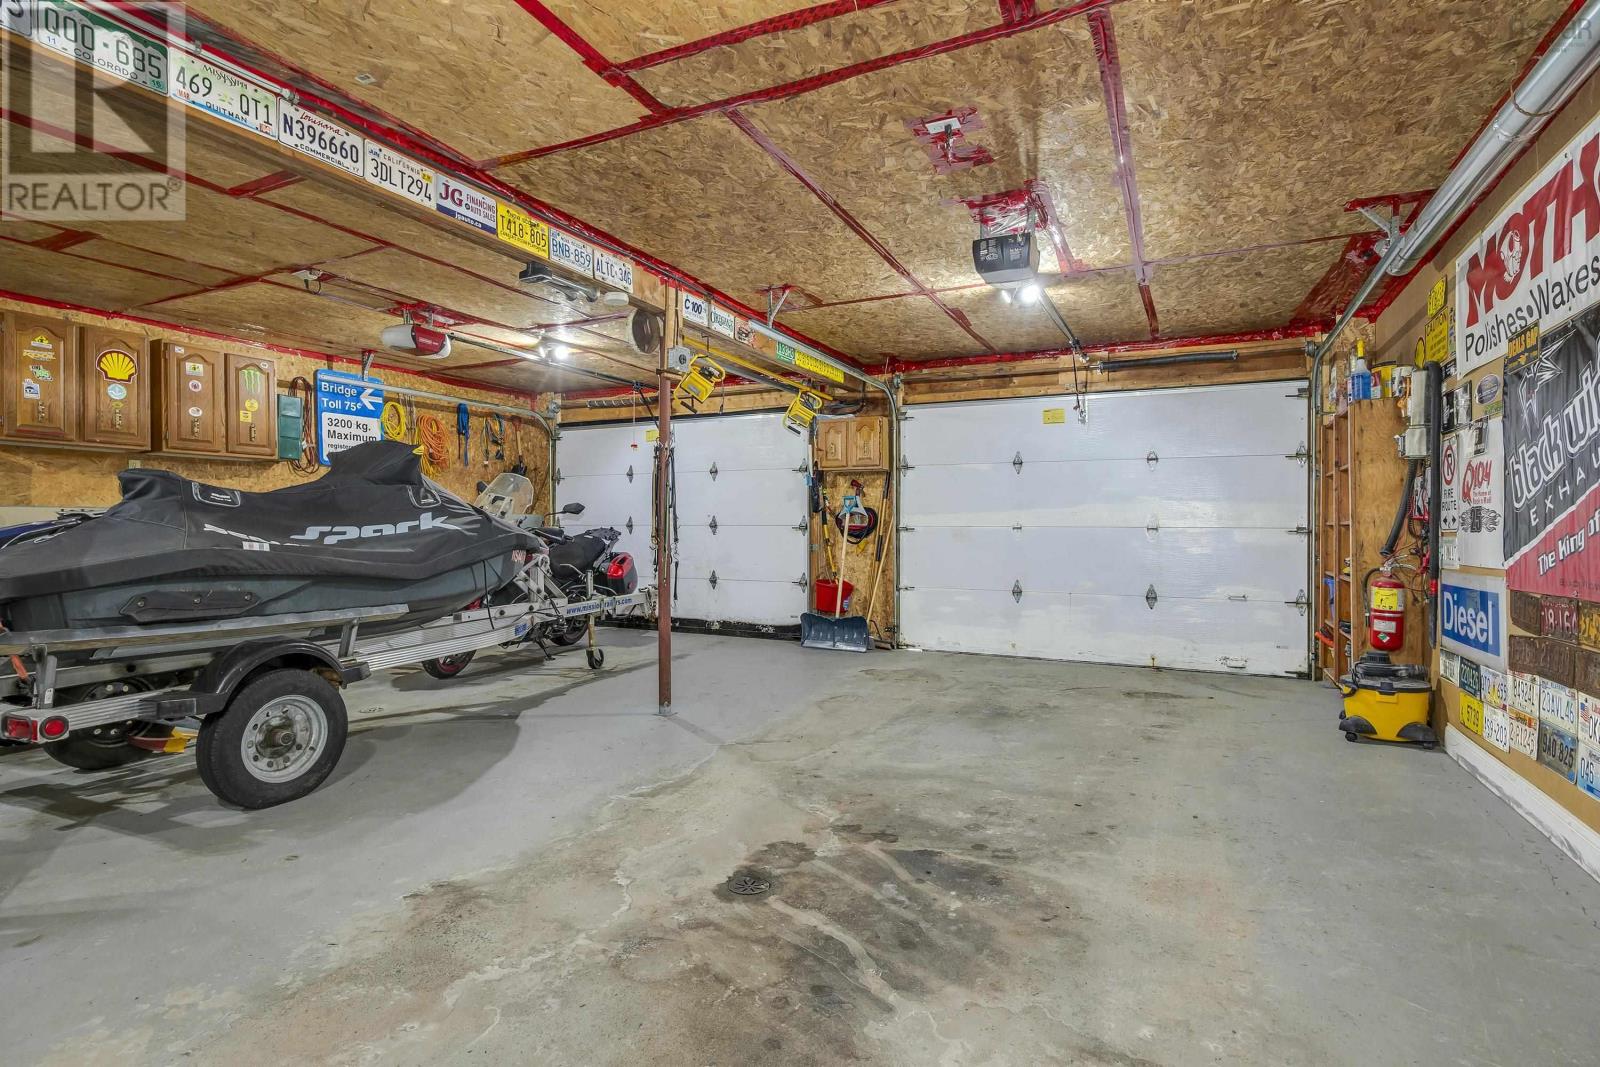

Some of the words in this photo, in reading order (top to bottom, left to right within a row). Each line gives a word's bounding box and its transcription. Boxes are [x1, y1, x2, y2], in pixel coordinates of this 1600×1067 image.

[74, 48, 138, 80] COLORADO
[176, 66, 213, 97] 469
[240, 94, 273, 126] QT1
[205, 101, 248, 124] QUITMAN
[283, 114, 359, 163] N396660
[299, 143, 346, 170] COMMERCIAL
[383, 153, 420, 175] CALIFORNIA
[370, 158, 432, 201] 3DLT294
[466, 193, 496, 214] FINANCING
[470, 204, 482, 216] AUTO
[482, 211, 496, 223] SALES
[1465, 132, 1600, 329] MOTH
[321, 381, 358, 398] Bridge
[321, 397, 341, 410] Toll
[327, 417, 353, 429] 3200
[327, 429, 377, 442] Maximum
[1537, 551, 1556, 577] The
[1558, 527, 1585, 561] King
[1443, 591, 1493, 645] Diesel
